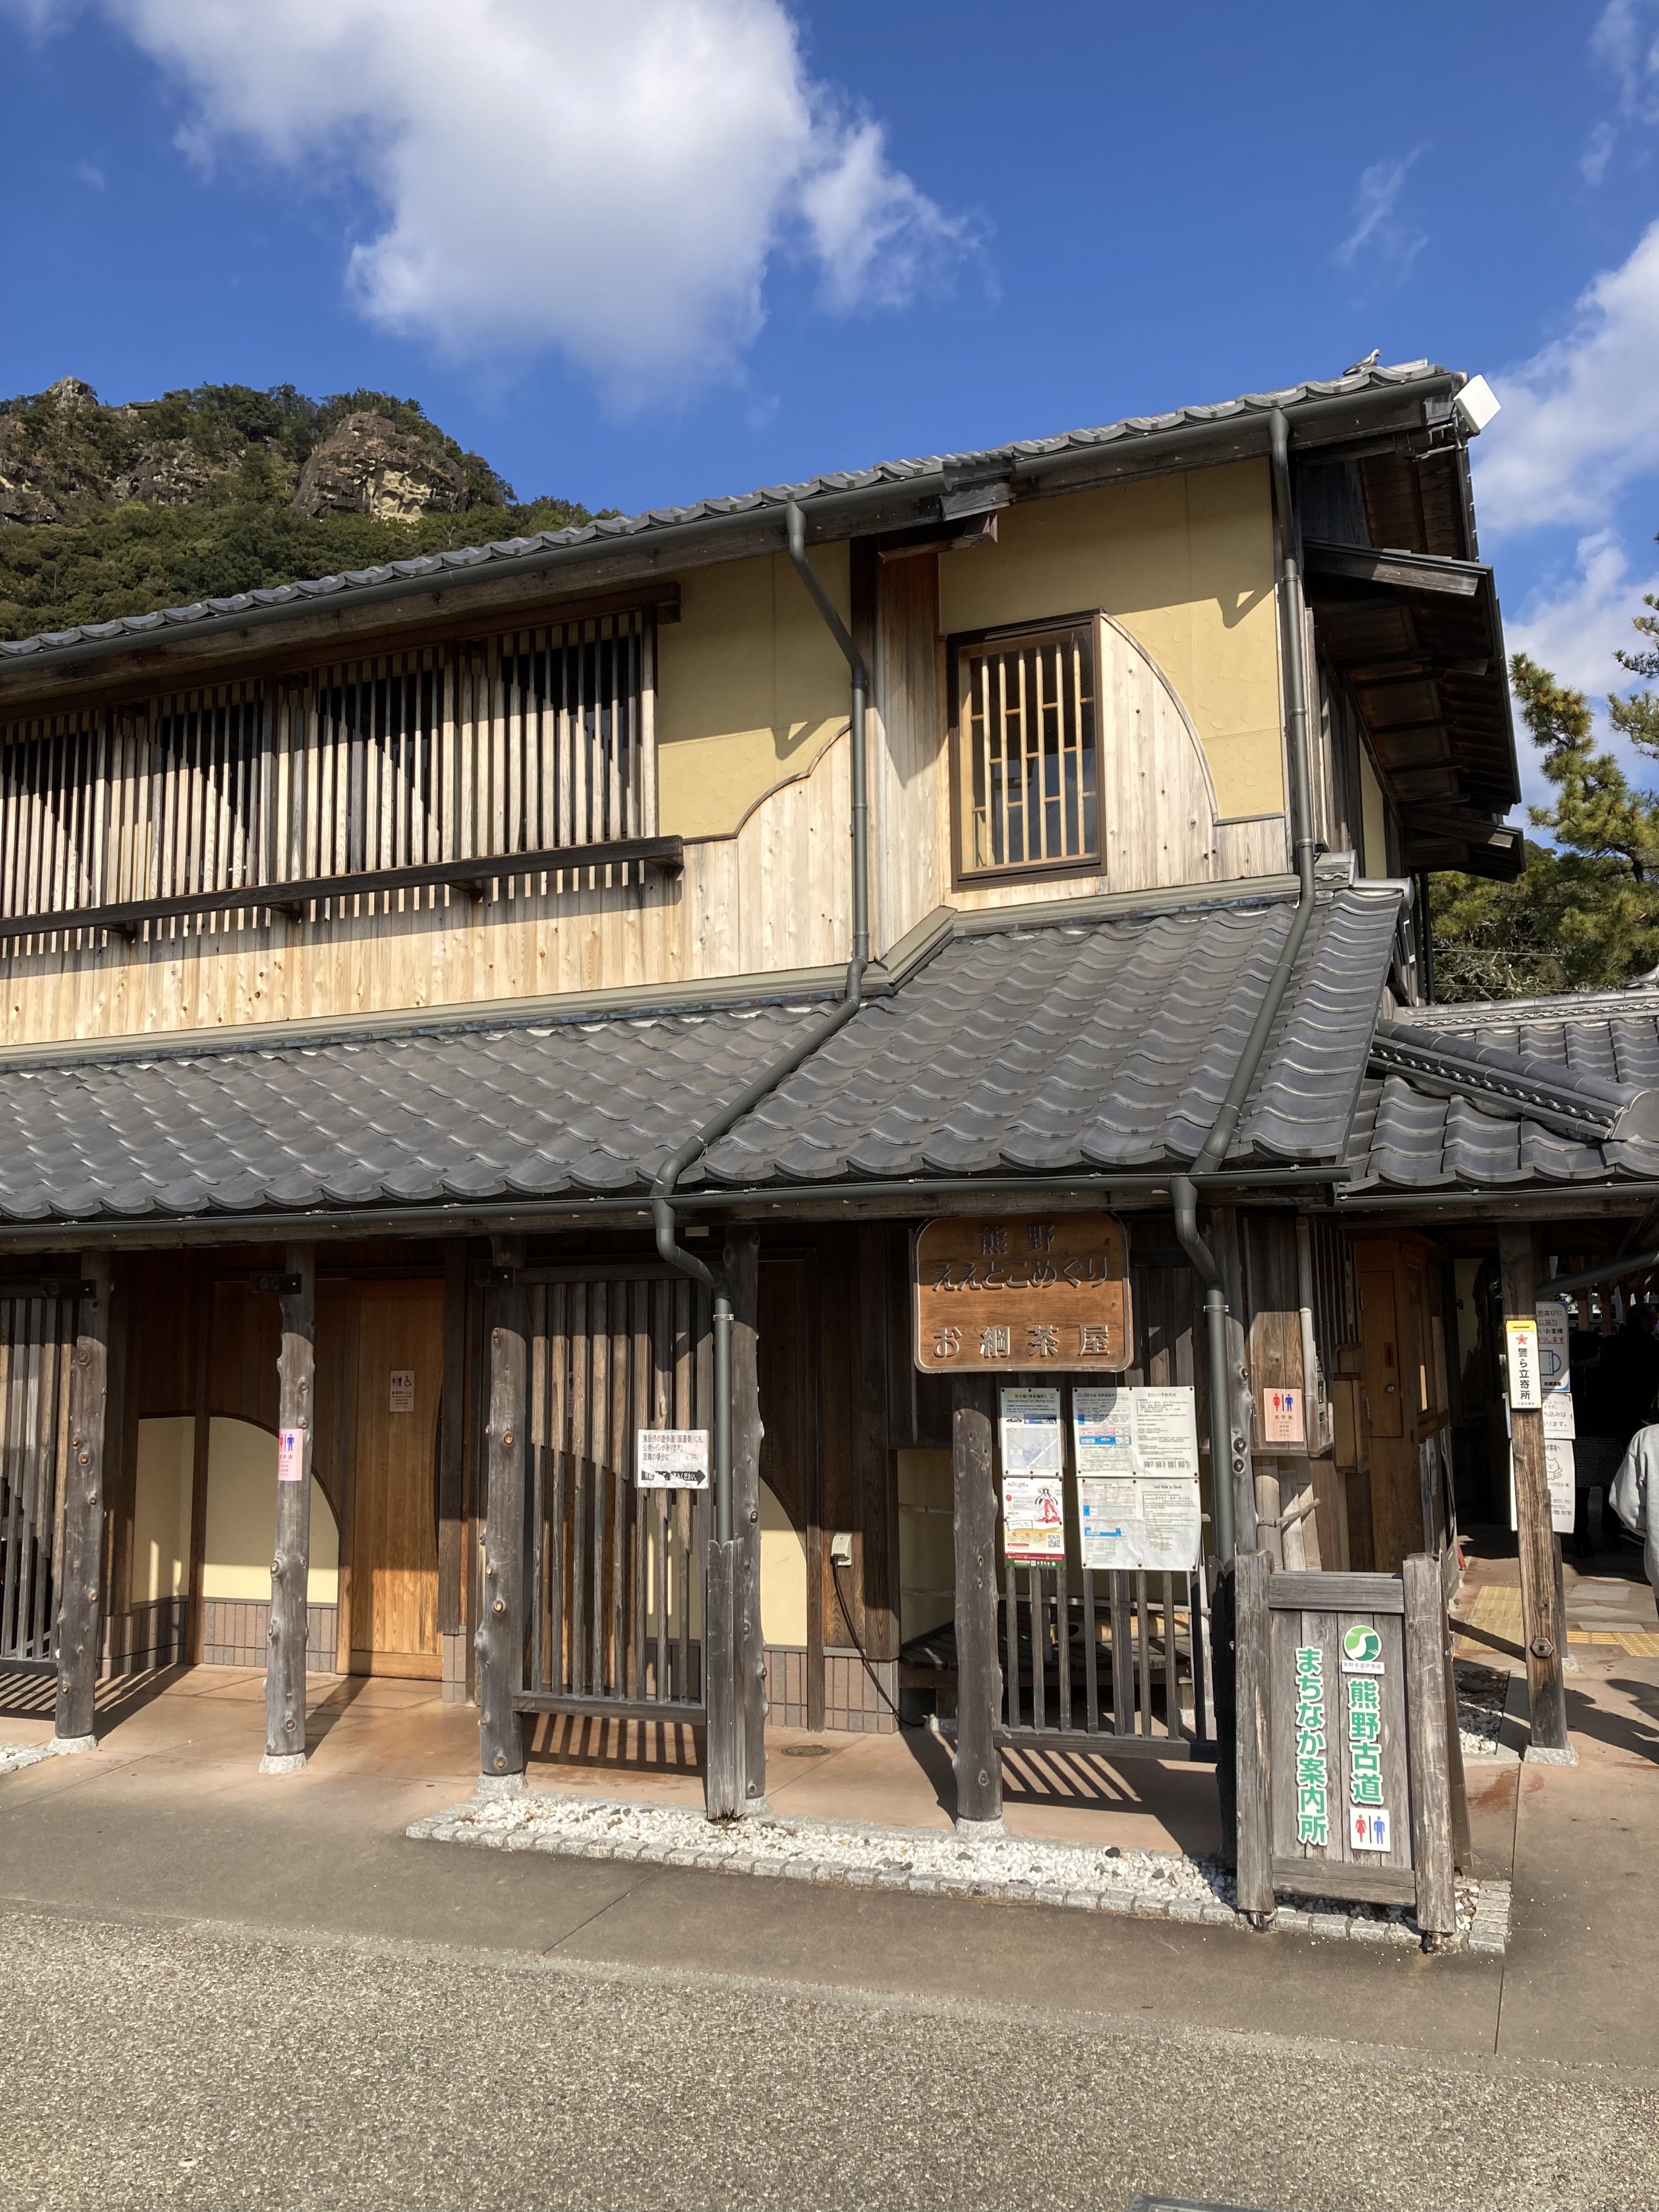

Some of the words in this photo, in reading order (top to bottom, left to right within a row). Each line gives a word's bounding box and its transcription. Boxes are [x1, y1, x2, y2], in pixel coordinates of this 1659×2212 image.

[980, 1223, 1056, 1255] 熊野
[931, 1257, 1108, 1292] ええとこめぐり
[933, 1324, 1111, 1358] お綱茶屋
[1518, 1347, 1530, 1400] 警ら立寄所
[1296, 1647, 1328, 1845] まちなか案内所
[1349, 1679, 1382, 1804] 熊野古道
